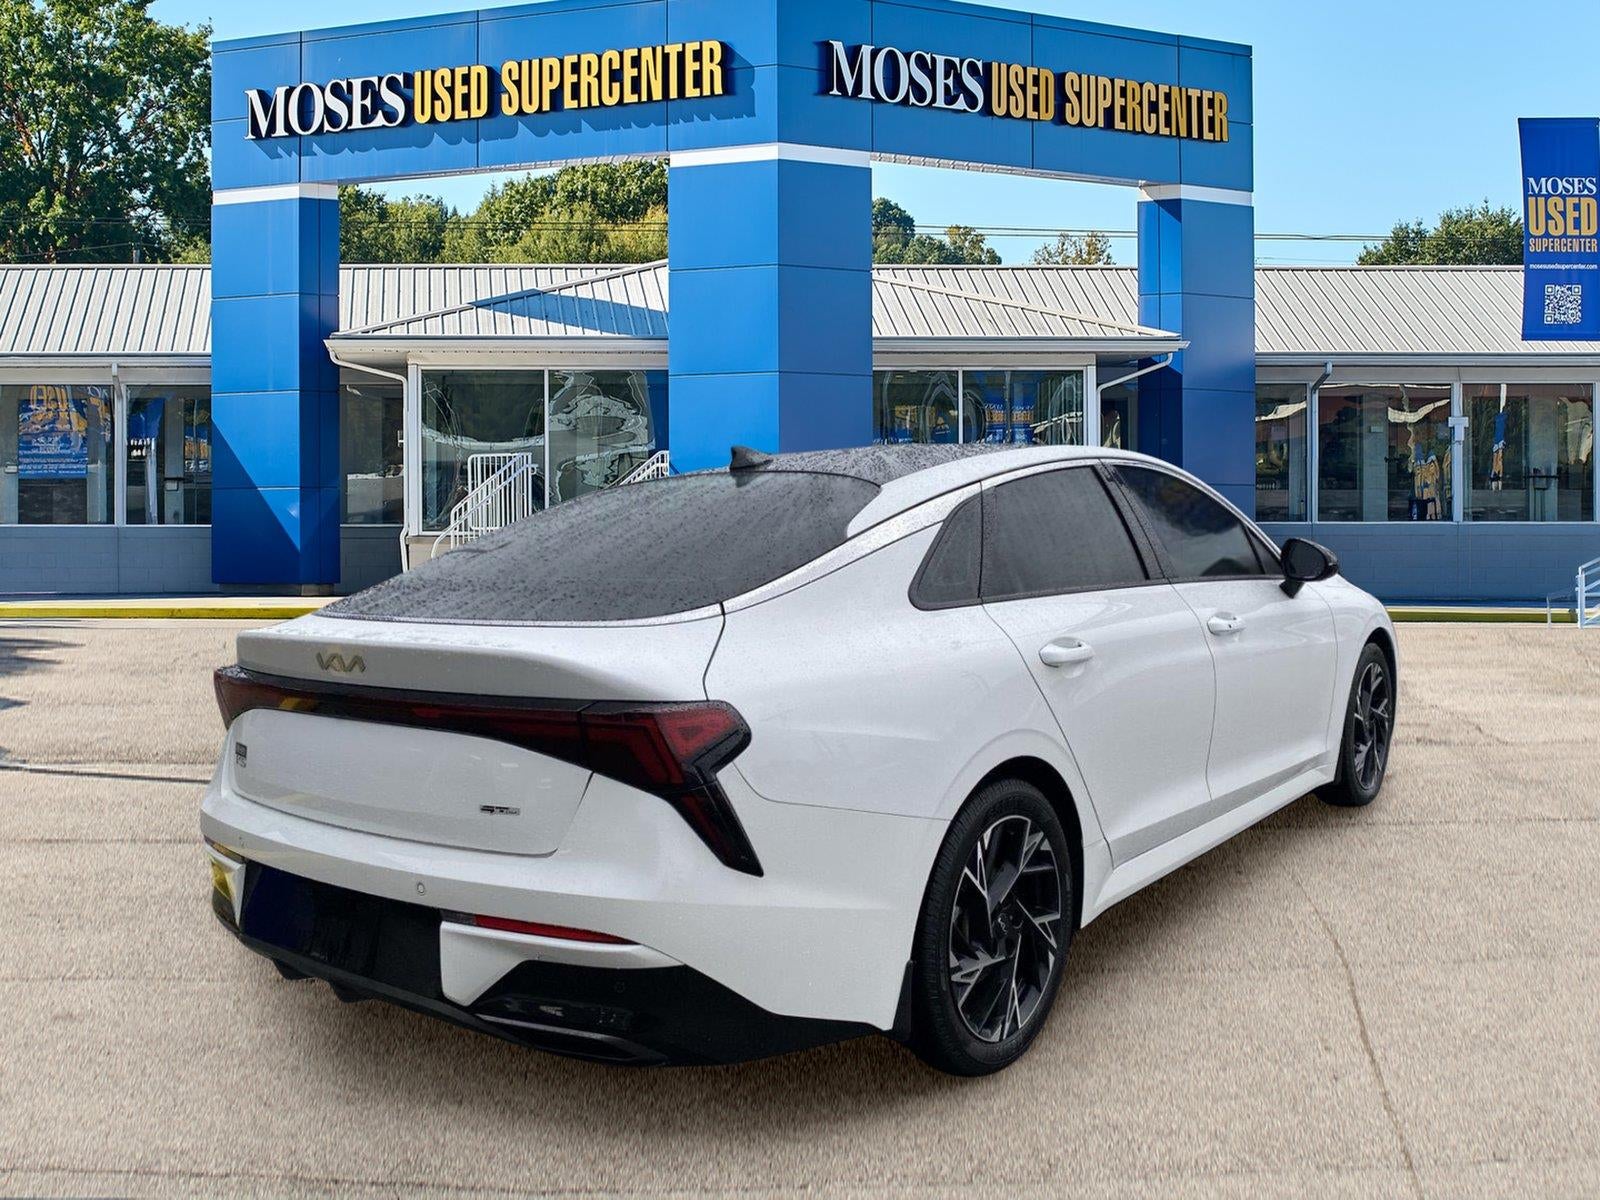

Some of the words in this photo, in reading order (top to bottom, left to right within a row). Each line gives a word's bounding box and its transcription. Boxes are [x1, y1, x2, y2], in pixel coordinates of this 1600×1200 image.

[244, 73, 408, 140] MOSES
[413, 65, 489, 125] USED
[501, 39, 725, 117] SUPERCENTER
[828, 39, 985, 113] MOSES
[991, 62, 1056, 122] USED
[1064, 71, 1230, 143] SUPERCENTER
[1527, 177, 1597, 196] MOSES
[1528, 196, 1598, 236] USED
[1529, 238, 1598, 253] SUPERCENTER
